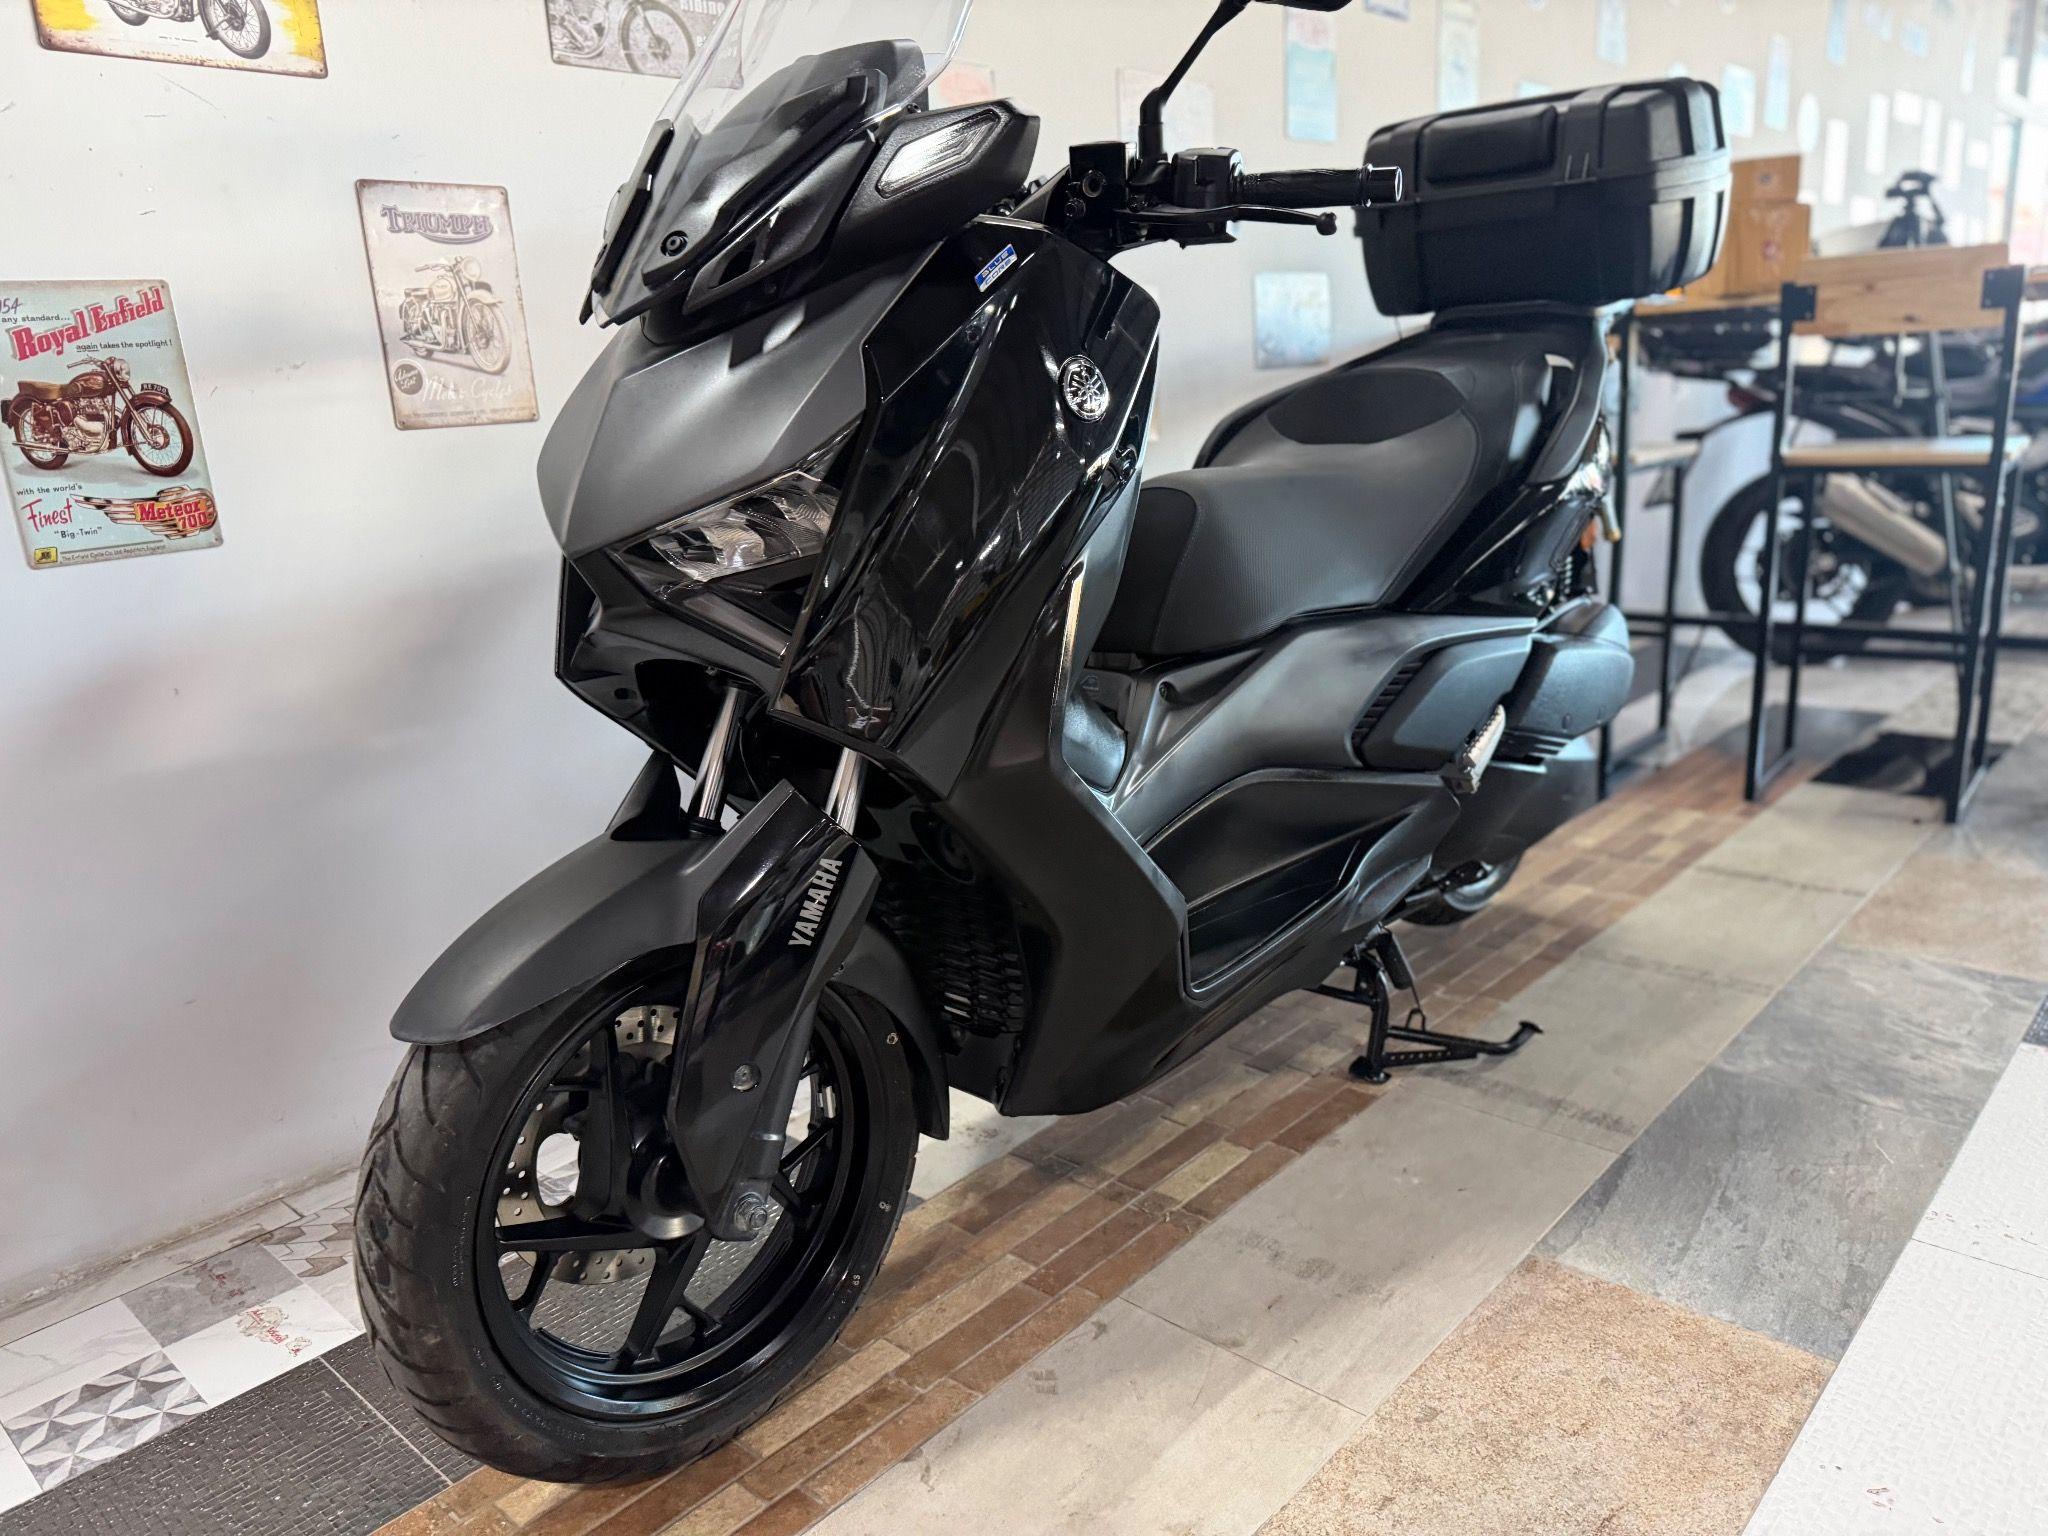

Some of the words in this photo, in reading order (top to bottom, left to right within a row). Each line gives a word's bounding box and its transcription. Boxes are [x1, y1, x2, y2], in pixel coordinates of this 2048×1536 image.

[380, 204, 492, 237] TRIUMPH
[982, 250, 1009, 278] BLUE
[985, 258, 1012, 285] CORE
[0, 297, 23, 315] 54
[1, 317, 18, 325] any
[21, 313, 70, 322] standard...
[10, 309, 91, 362] Royal
[88, 286, 165, 334] Enfield
[76, 344, 99, 352] again
[99, 341, 120, 350] takes
[121, 340, 134, 349] the
[16, 488, 35, 496] with
[37, 486, 50, 494] the
[52, 483, 82, 493] world's
[21, 497, 73, 532] Finest
[136, 500, 201, 522] Meteor
[178, 511, 209, 529] 700
[788, 858, 842, 946] YAMAHA
